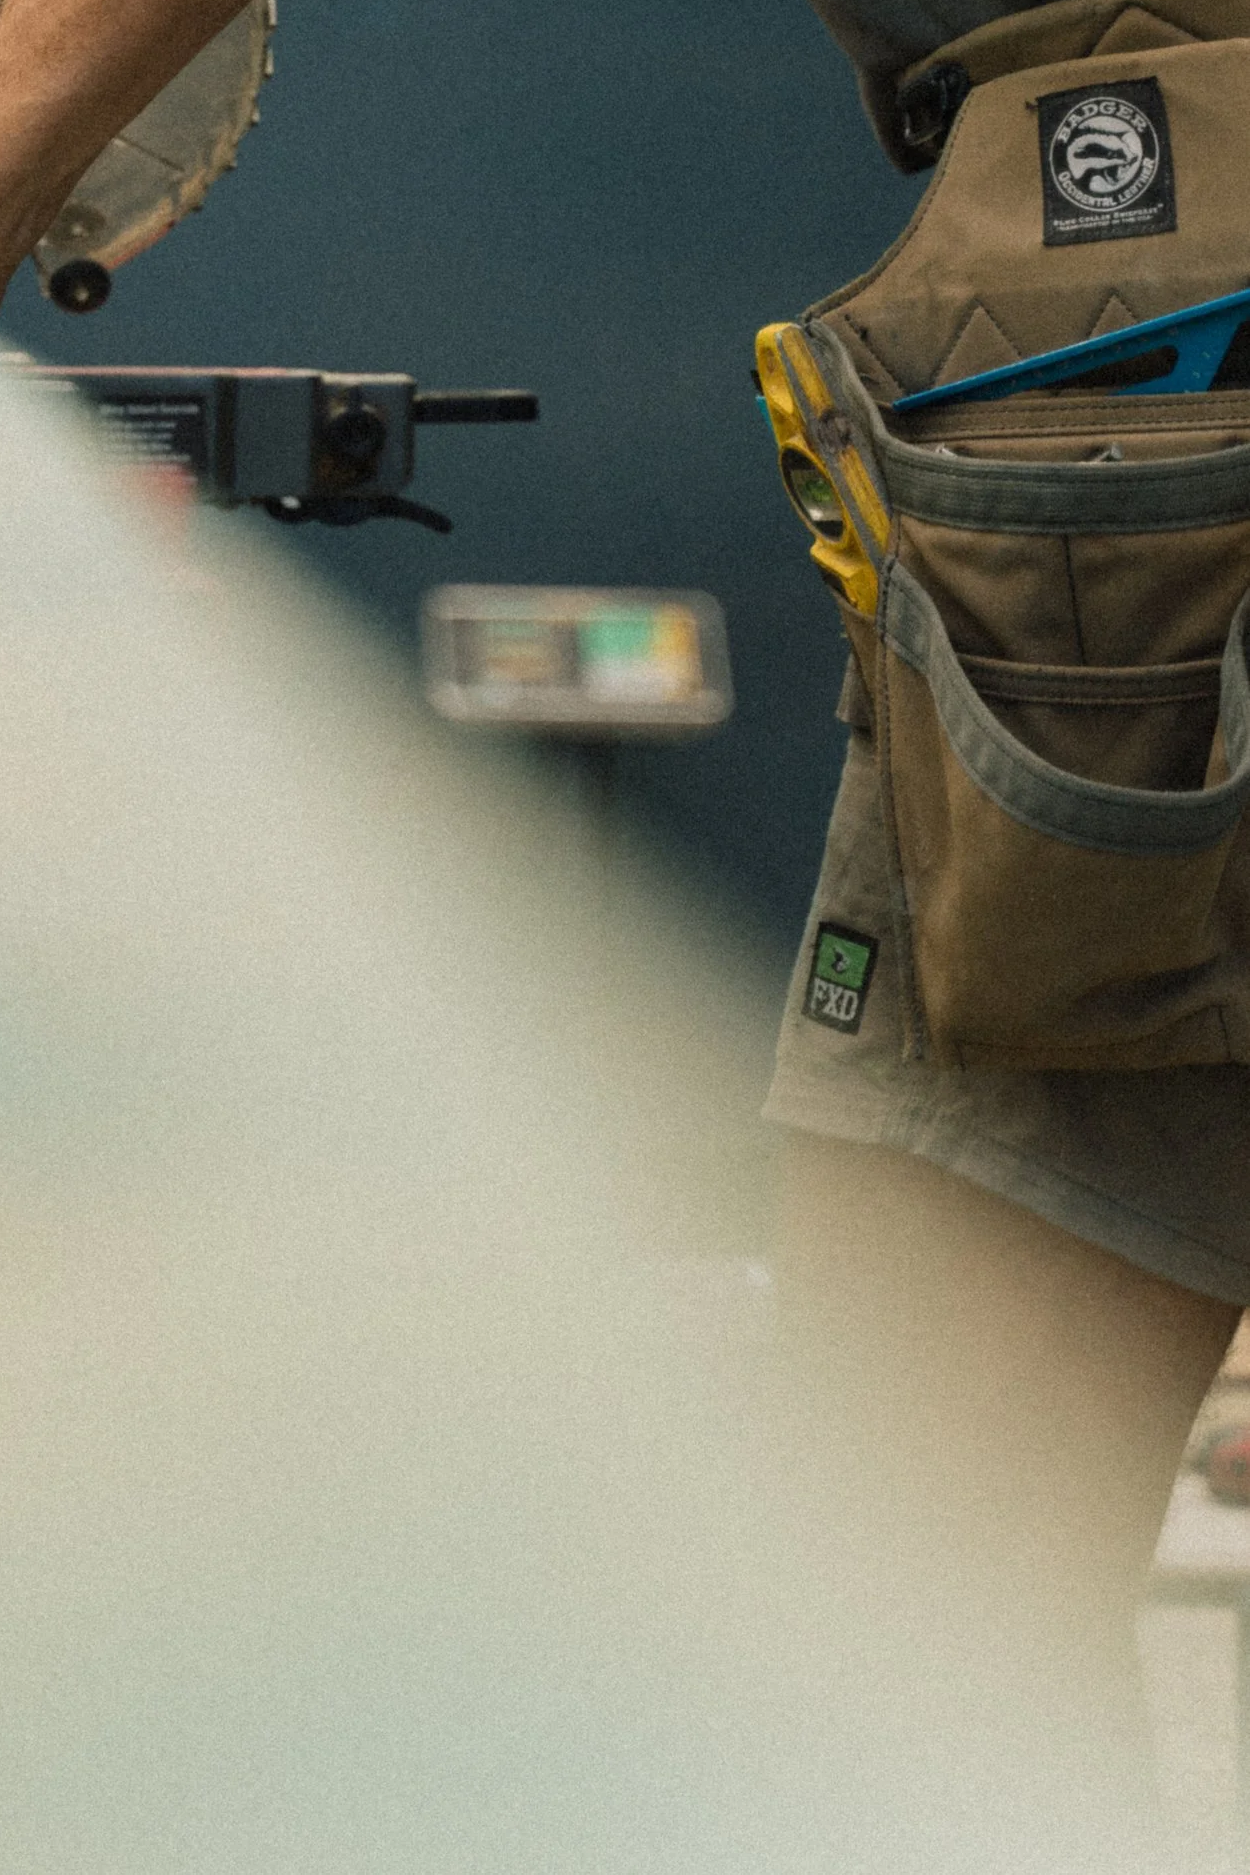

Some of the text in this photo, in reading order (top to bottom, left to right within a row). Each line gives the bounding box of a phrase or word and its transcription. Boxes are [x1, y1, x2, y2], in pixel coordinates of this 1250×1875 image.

[1057, 101, 1147, 143] BADGER
[1058, 157, 1155, 207] OCCIDENTAL LEATHER
[810, 977, 859, 1022] FXD
